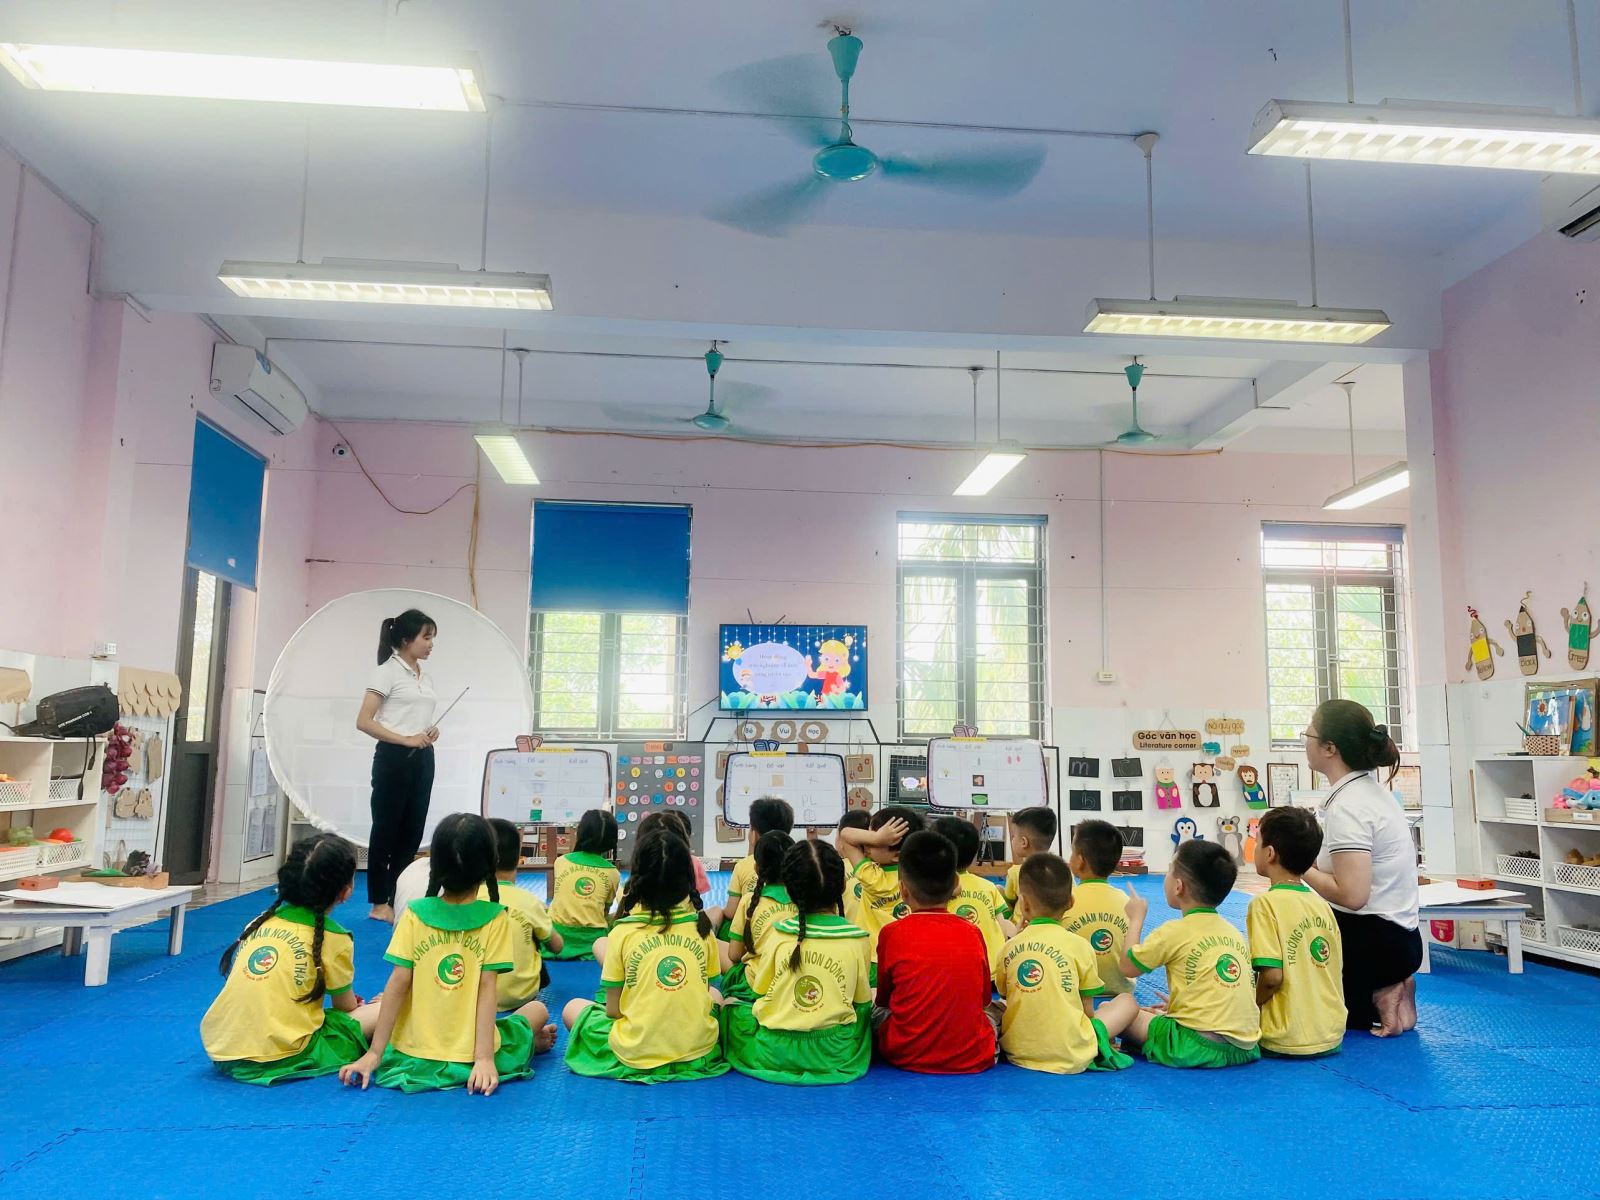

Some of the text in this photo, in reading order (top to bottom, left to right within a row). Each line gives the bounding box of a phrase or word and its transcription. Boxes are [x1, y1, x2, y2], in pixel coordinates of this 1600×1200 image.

[1137, 731, 1157, 740] Góc
[1071, 760, 1089, 776] m
[1098, 911, 1115, 923] NON
[271, 927, 294, 941] NON
[663, 933, 683, 947] NON
[1026, 941, 1047, 953] NON
[1217, 935, 1236, 948] NON
[804, 950, 825, 967] NON
